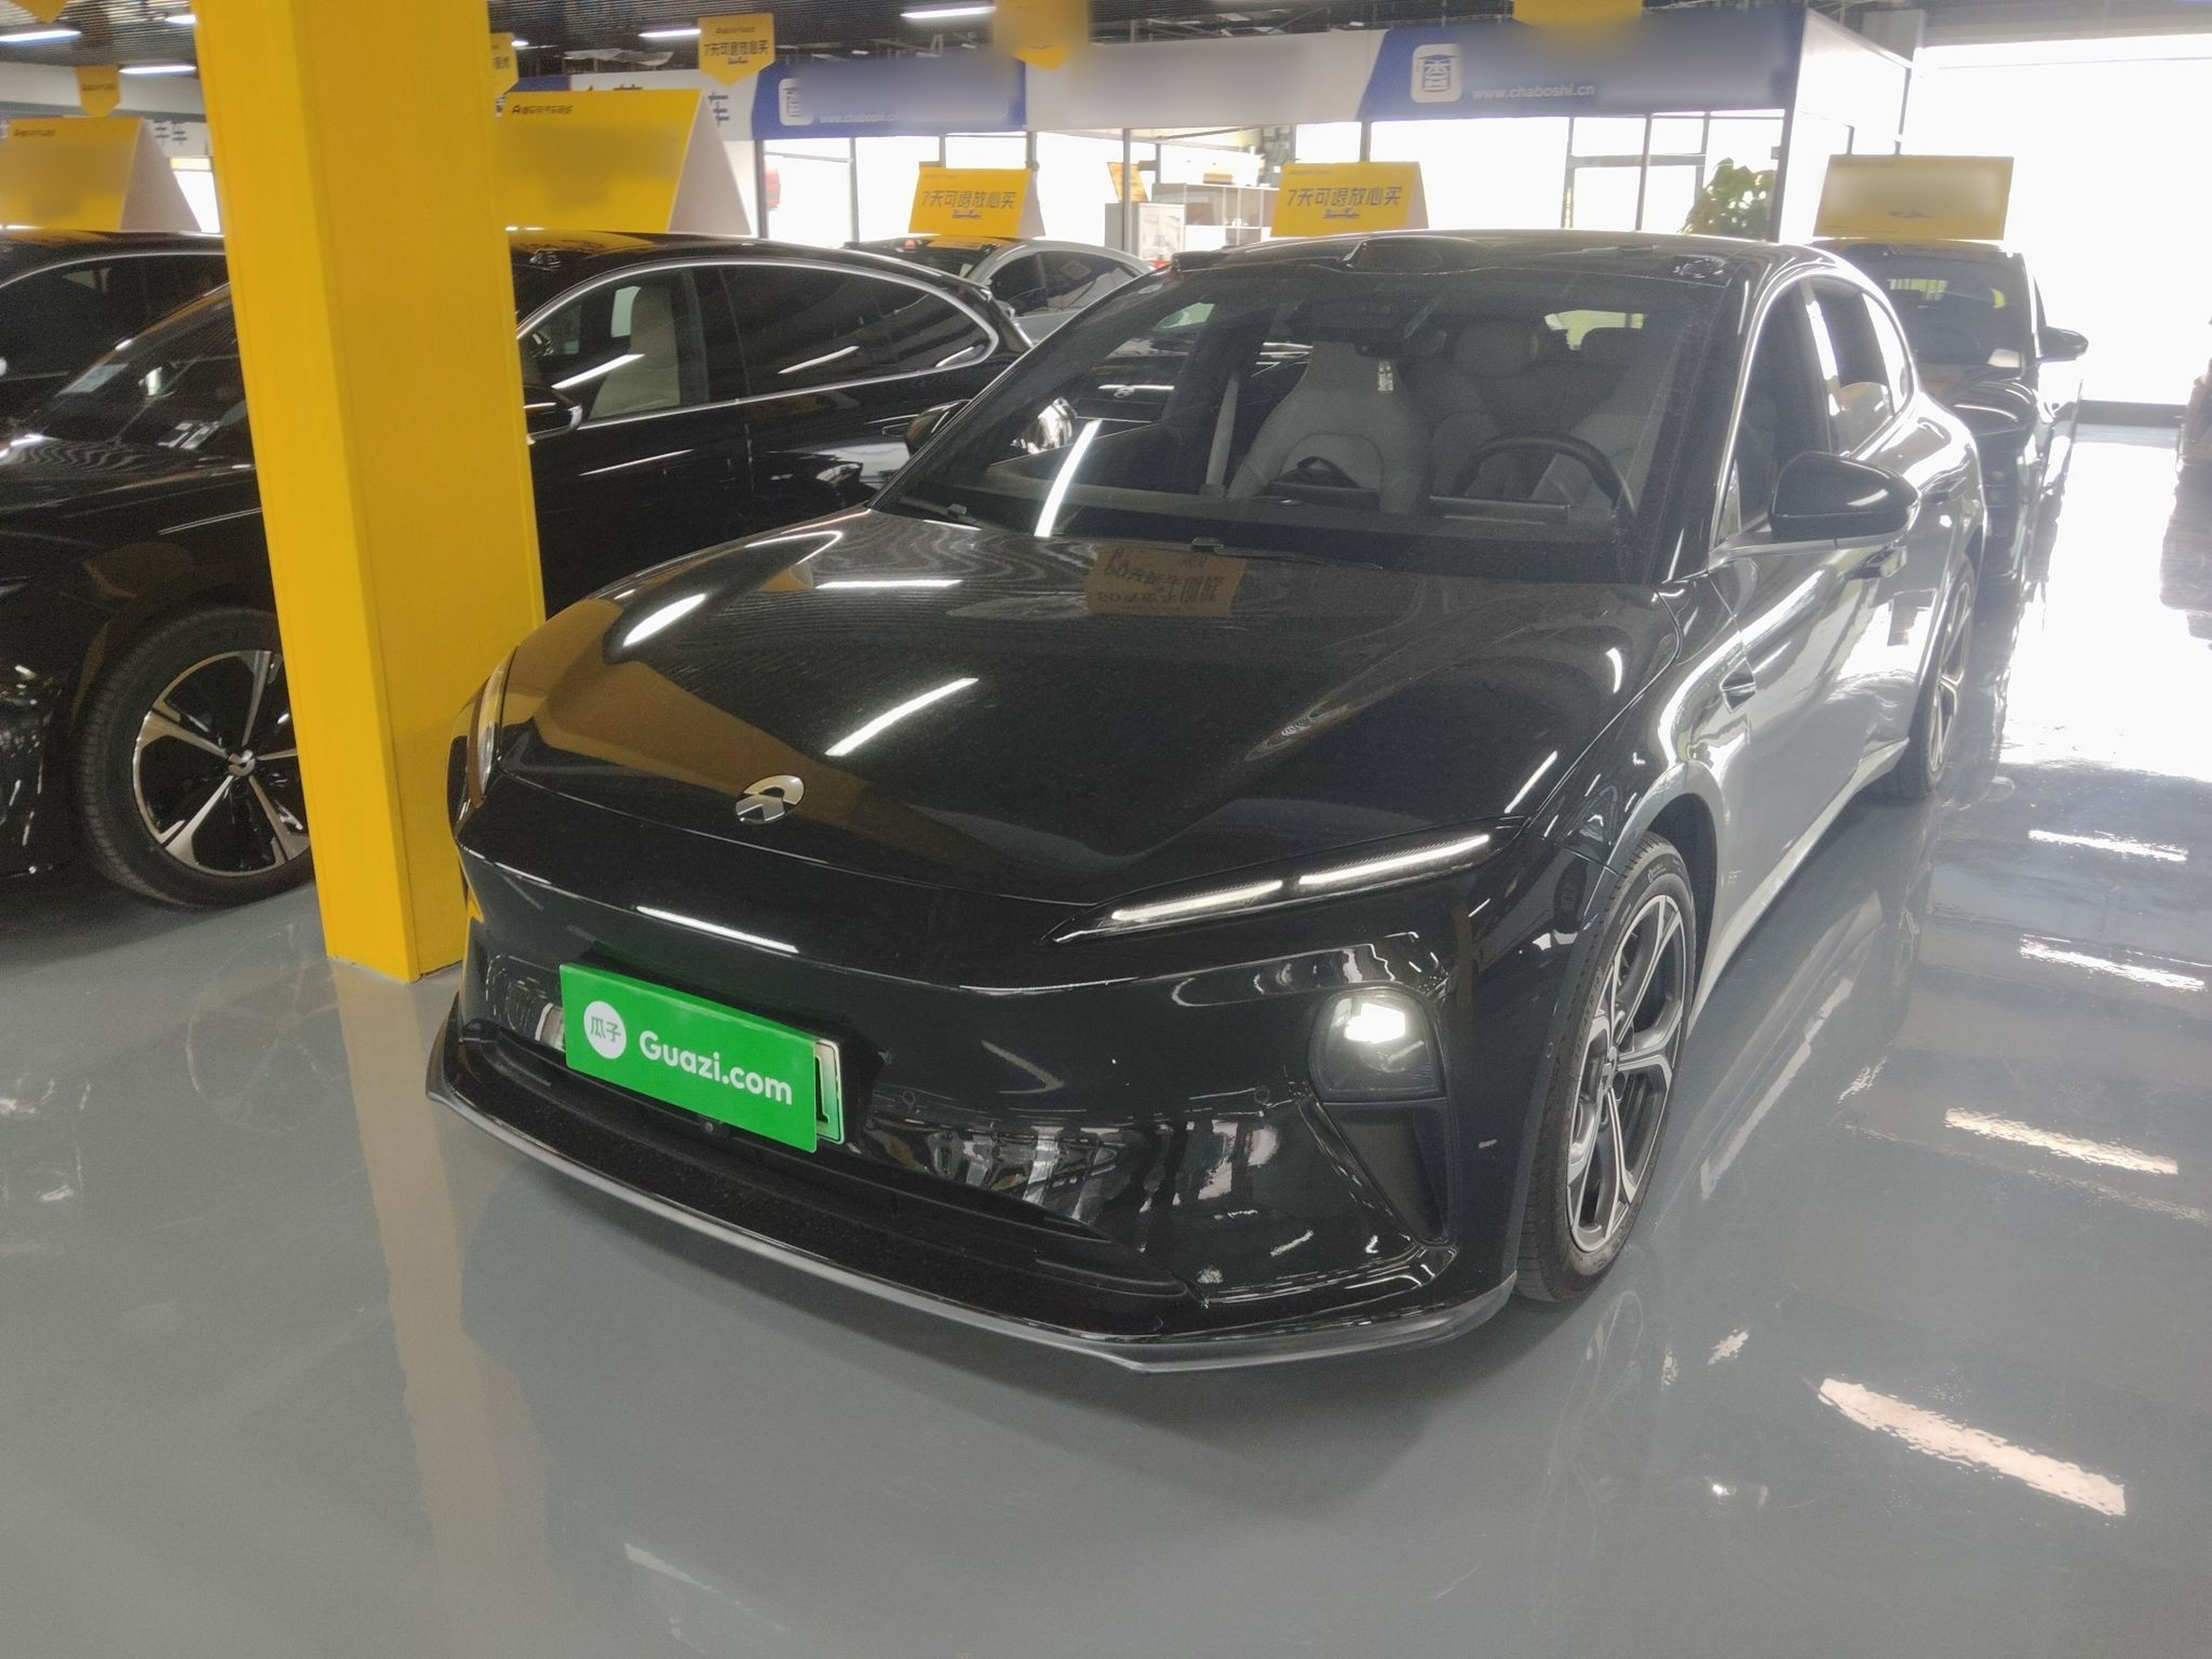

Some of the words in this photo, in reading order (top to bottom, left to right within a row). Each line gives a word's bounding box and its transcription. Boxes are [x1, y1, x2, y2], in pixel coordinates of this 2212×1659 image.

[1472, 84, 1595, 100] www.chaboshi.cn
[922, 191, 1016, 209] 7天可退放心买
[1287, 185, 1402, 207] 7天可退放心买
[590, 1016, 622, 1043] 瓜子
[639, 1030, 793, 1107] Guazi.com
